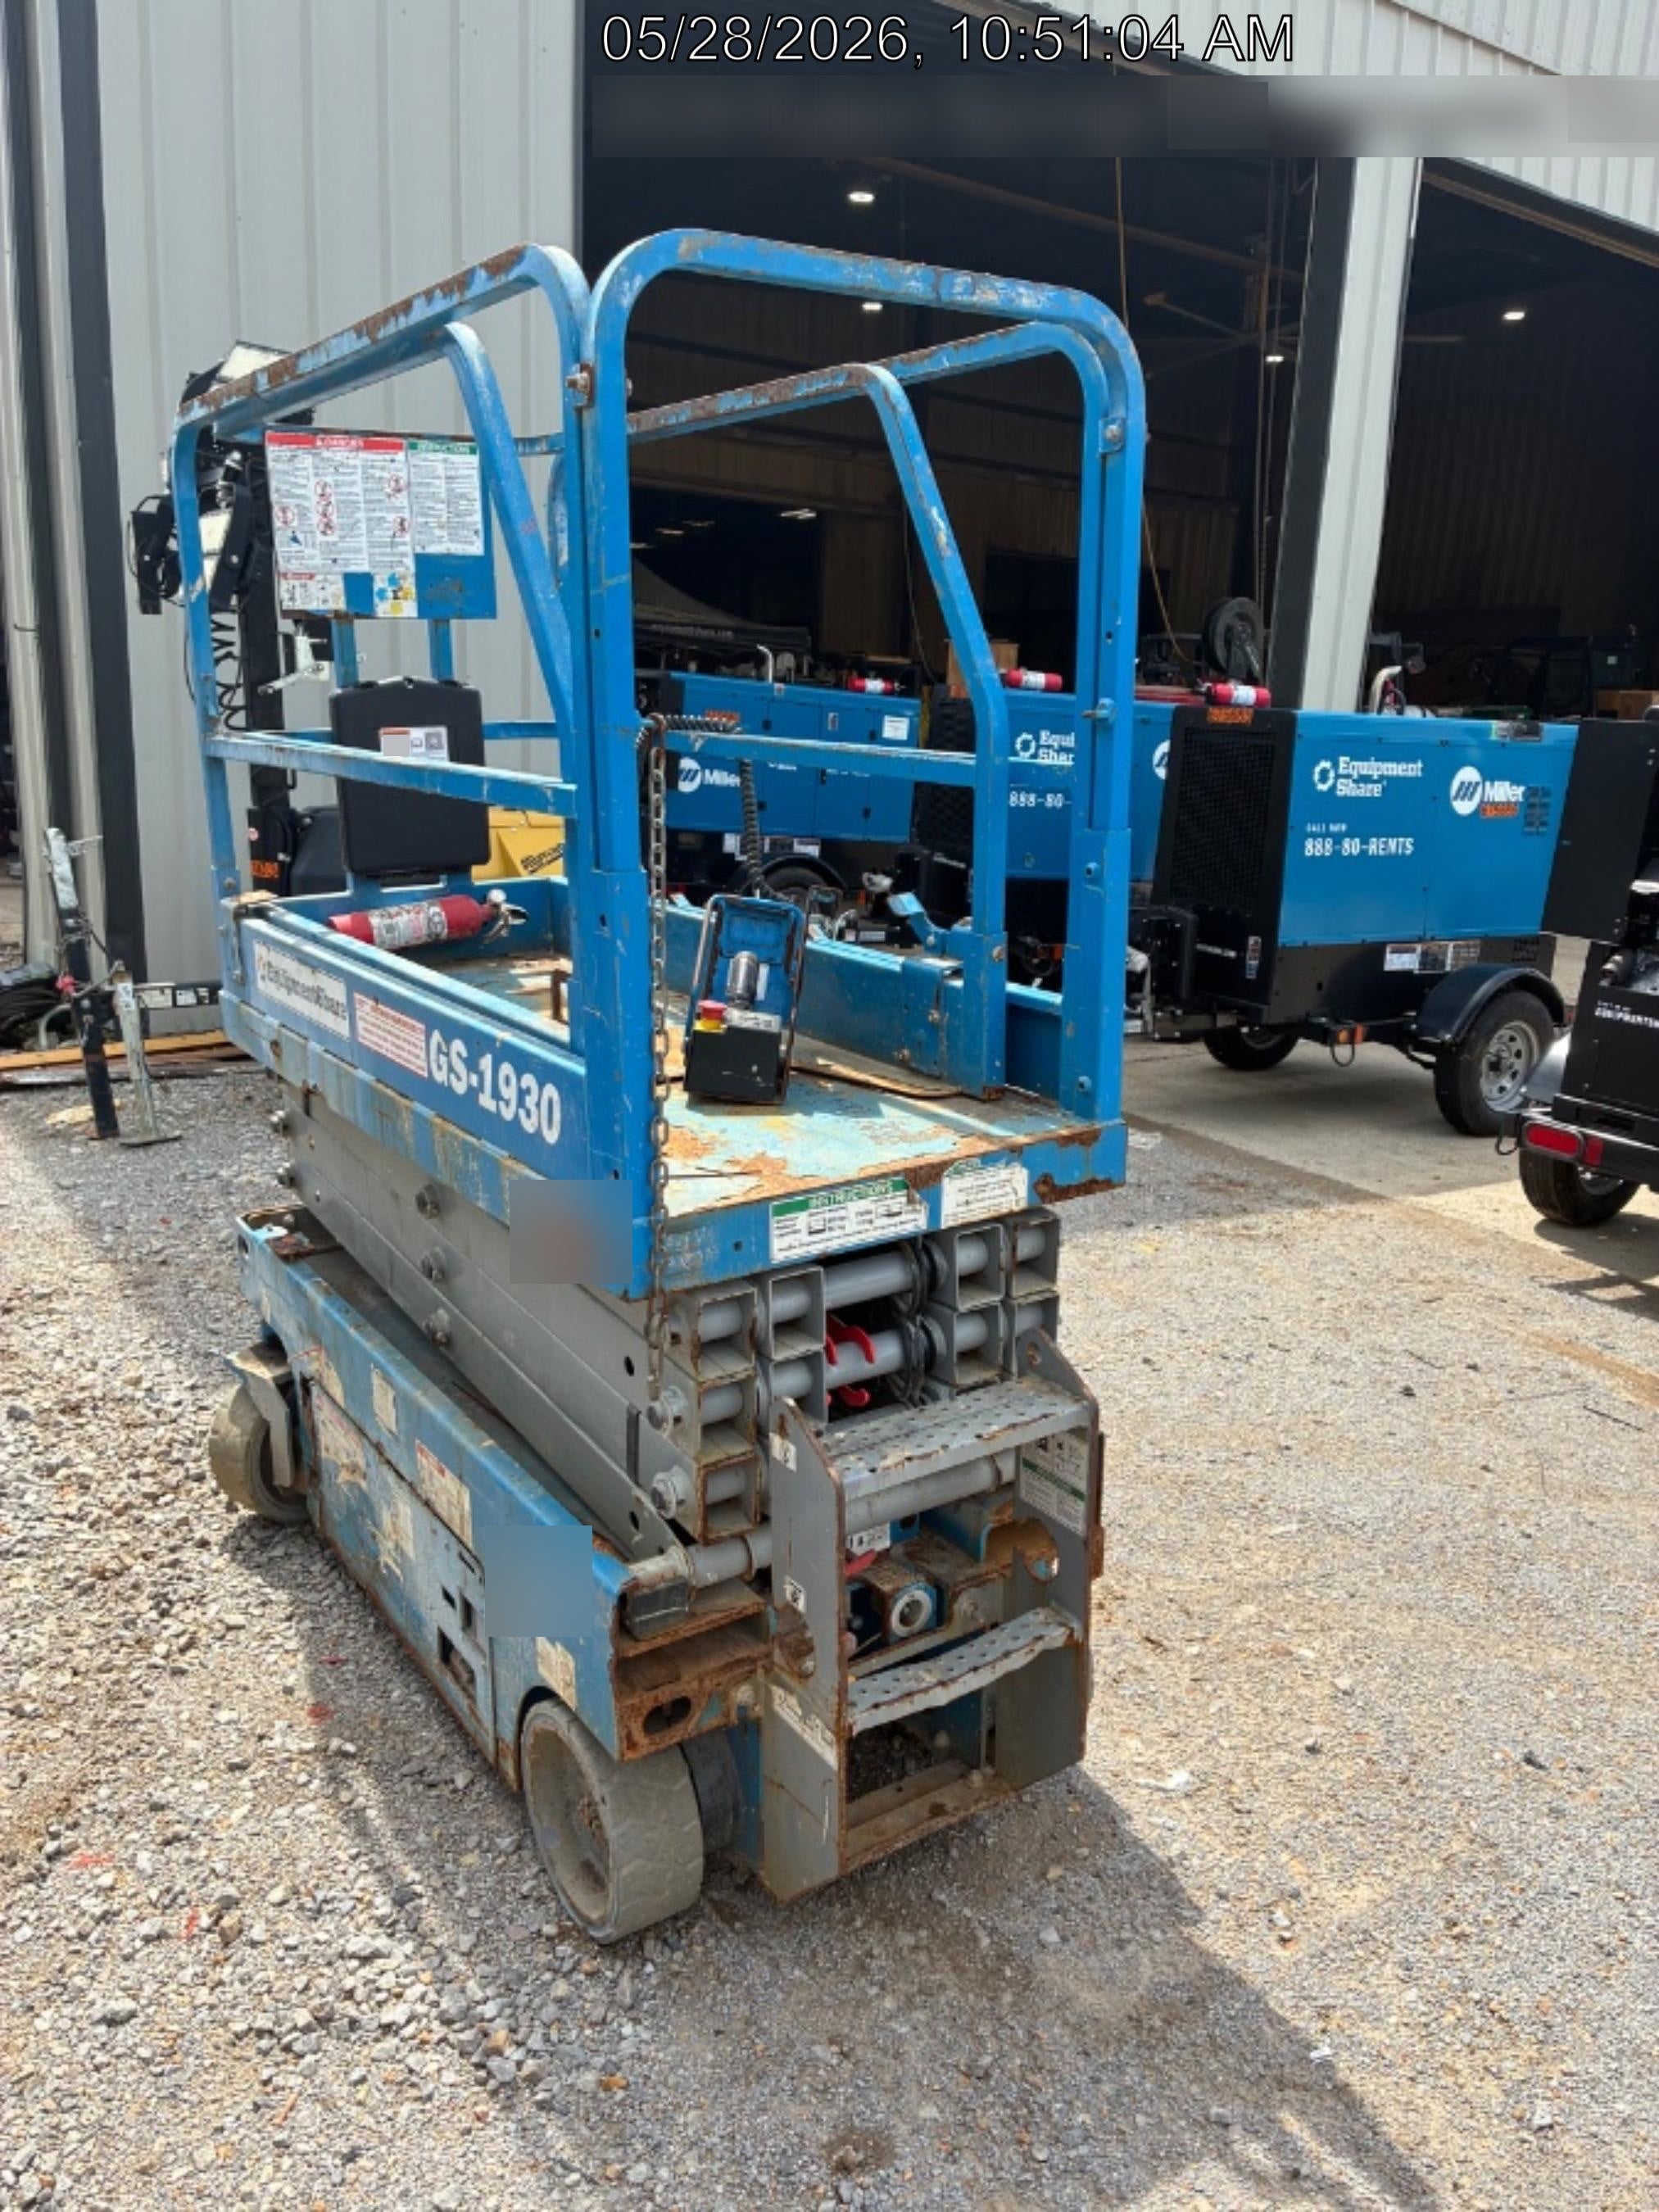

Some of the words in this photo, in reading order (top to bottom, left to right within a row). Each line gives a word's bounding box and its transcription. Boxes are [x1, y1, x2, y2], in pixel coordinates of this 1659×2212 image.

[1038, 747, 1075, 763] Shar
[1337, 756, 1423, 779] Equipment
[1336, 778, 1383, 797] Share
[1484, 780, 1525, 802] Miller
[1303, 837, 1415, 856] 888-80-RENTS
[429, 1029, 561, 1144] GS-1930
